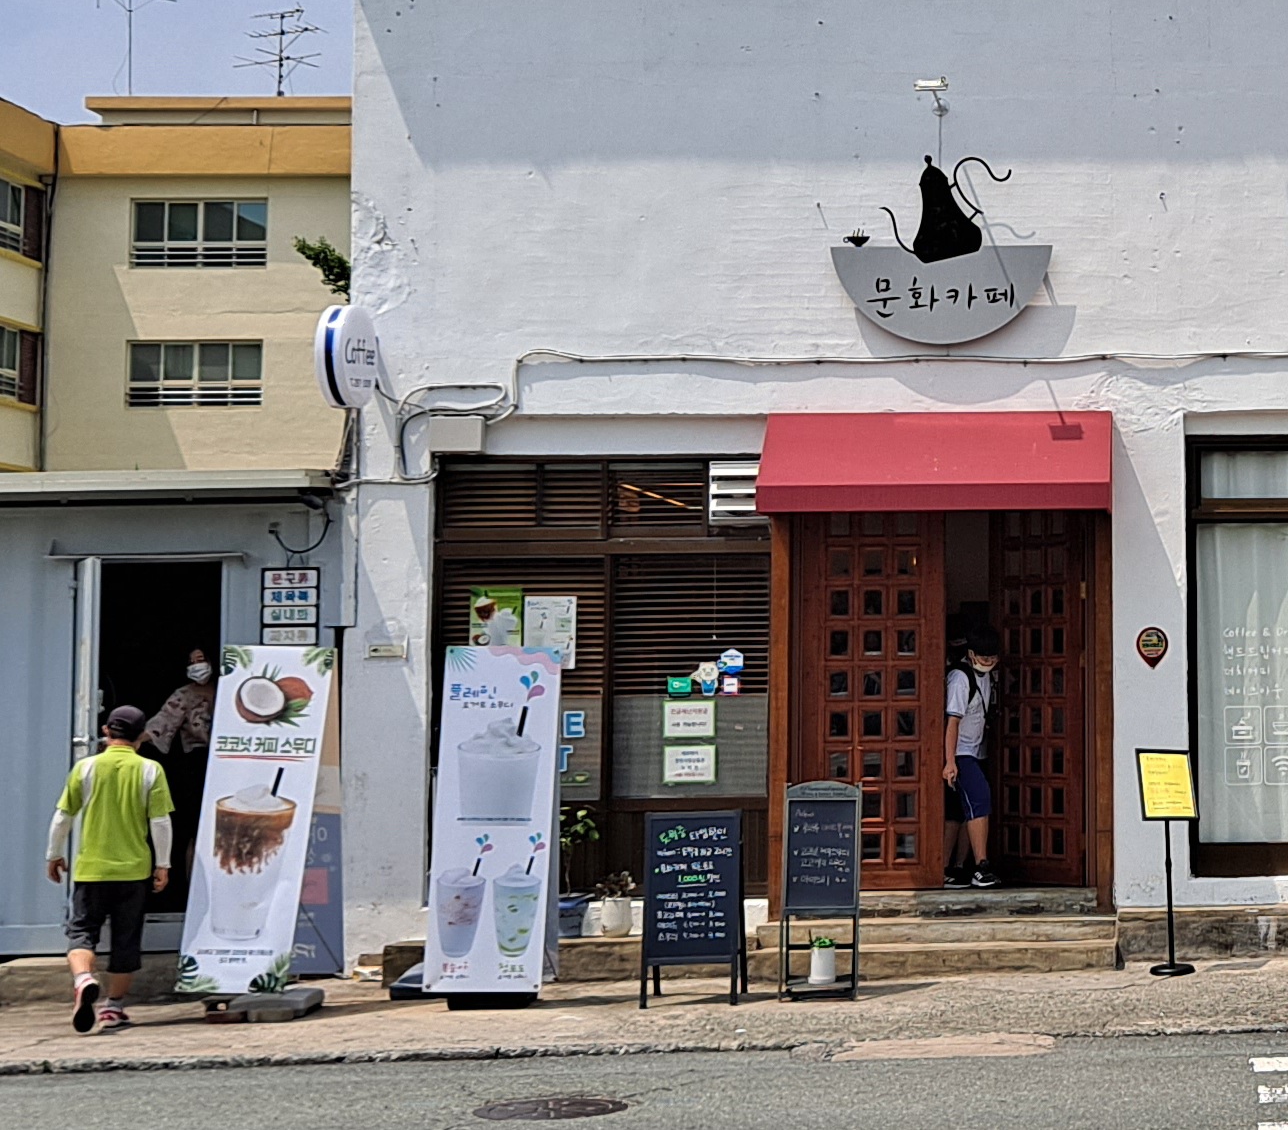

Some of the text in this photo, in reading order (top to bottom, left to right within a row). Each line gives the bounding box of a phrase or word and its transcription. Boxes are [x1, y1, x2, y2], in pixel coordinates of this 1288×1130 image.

[866, 276, 1015, 319] 문화카페
[345, 337, 375, 366] Coffee
[1223, 627, 1257, 638] Coffee
[1262, 627, 1271, 637] &
[449, 683, 497, 701] 플레인
[215, 735, 317, 754] 코코넛 커피 스무디
